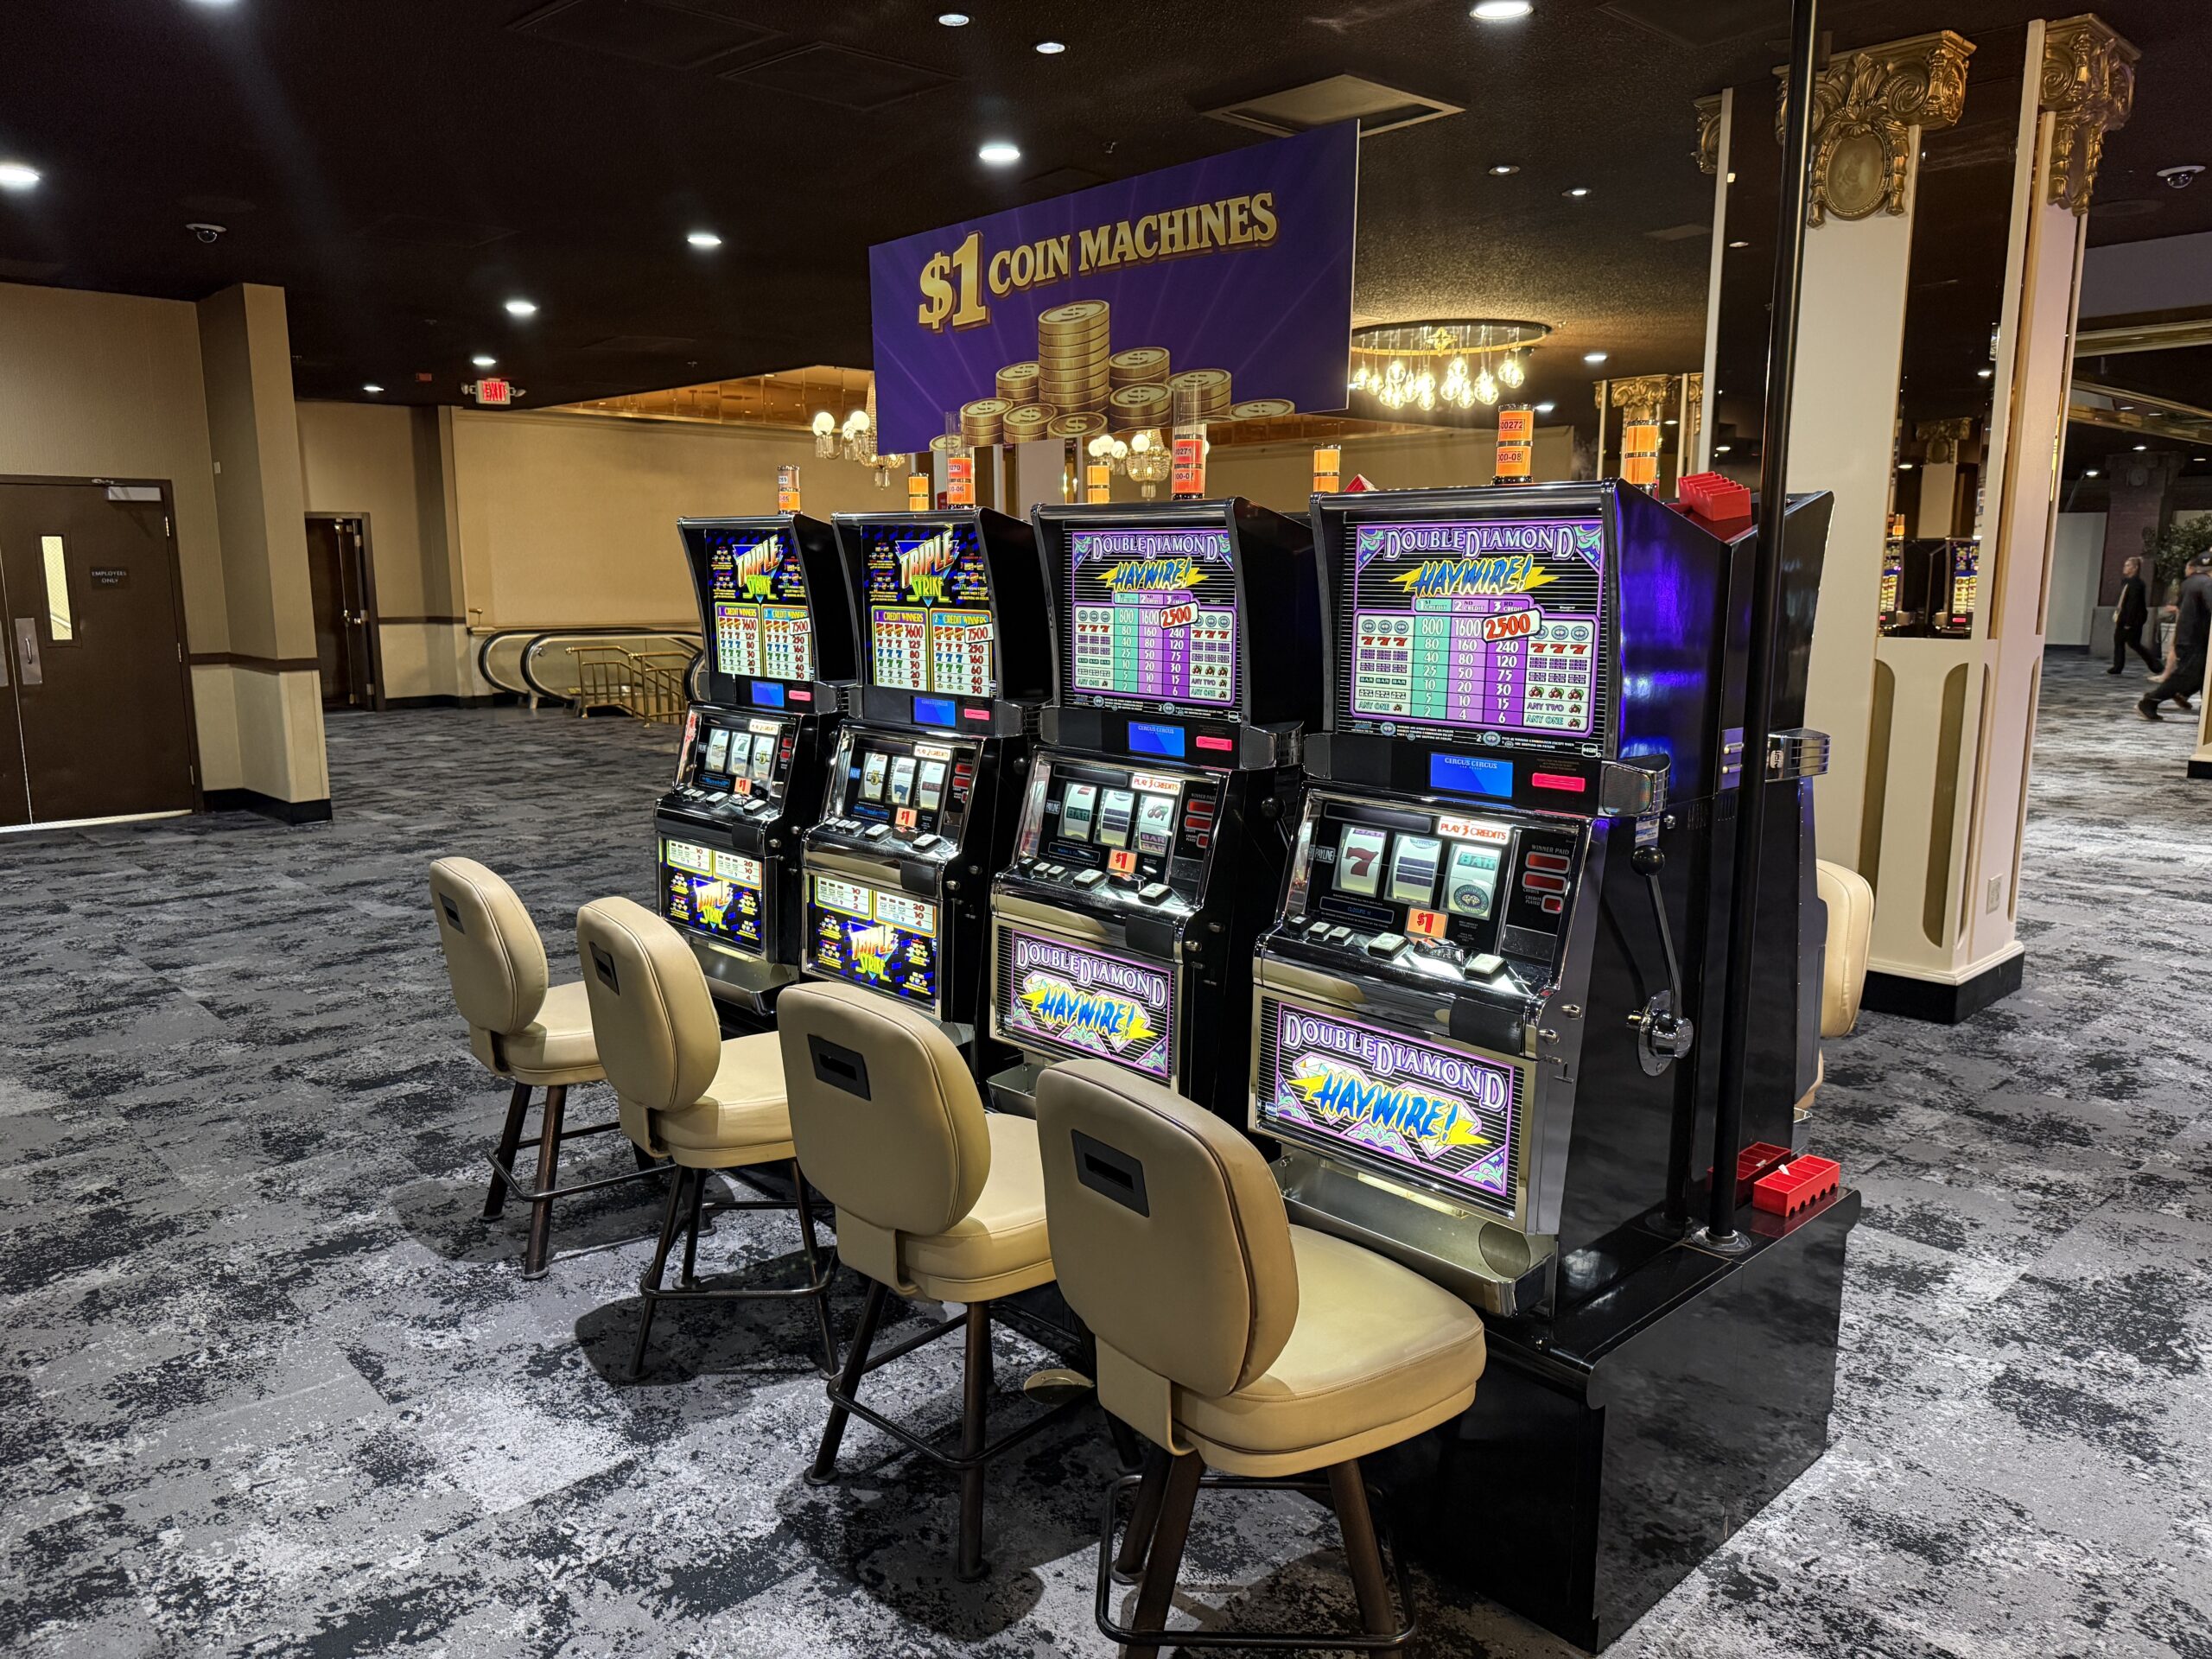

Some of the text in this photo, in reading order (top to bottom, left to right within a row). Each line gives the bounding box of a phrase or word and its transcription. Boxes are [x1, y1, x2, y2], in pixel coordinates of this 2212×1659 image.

[918, 192, 1278, 331] $1 COIN MACHINES
[483, 380, 506, 402] EXIT
[735, 534, 779, 588] TRIPLE
[899, 528, 955, 589] TRIPLE
[1109, 557, 1192, 592] HAYWIRE!
[1408, 554, 1534, 597] HAYWIRE!
[906, 575, 950, 603] STRIKE
[883, 612, 924, 622] CREDIT WINNERS
[944, 614, 987, 624] CREDIT WINNERS
[1119, 605, 1192, 627] 800 1600 2500
[791, 620, 809, 632] 7500
[967, 626, 988, 641] 7500
[1121, 626, 1185, 639] 80 160 240
[1421, 613, 1531, 640] 800 1600 2500
[1121, 638, 1185, 650] 40 80 120
[1424, 638, 1519, 653] 80 160 240
[969, 655, 984, 664] 160
[1121, 648, 1181, 662] 25 50 75
[1424, 652, 1440, 663] 40
[1458, 653, 1474, 664] 80
[1496, 655, 1517, 668] 120
[970, 665, 982, 675] 60
[1122, 659, 1181, 673] 10 20 30
[1423, 665, 1513, 682] 25 50 75
[970, 677, 982, 686] 40
[1123, 671, 1180, 684] 5 10 15
[1123, 683, 1179, 696] 2 4 6
[1424, 679, 1436, 690] 10
[1457, 681, 1472, 693] 20
[1496, 683, 1512, 696] 30
[1426, 692, 1510, 710] 5 10 15
[1526, 702, 1565, 712] ANY TWO
[1424, 706, 1506, 724] 2 4 6
[1525, 715, 1564, 725] ANY ONE
[1445, 757, 1471, 766] CIRCUS
[1147, 779, 1154, 789] 3
[1154, 781, 1179, 791] CREDITS
[900, 810, 910, 824] $1
[1067, 808, 1090, 820] BAR
[1141, 833, 1165, 843] BAR
[1440, 823, 1507, 840] PLAY 3 CREDITS
[1143, 842, 1165, 852] BAR
[1314, 848, 1334, 861] PAYLINE
[1531, 844, 1570, 855] WINNER PAID
[1115, 852, 1128, 869] $1
[1345, 846, 1379, 878] 7
[1458, 854, 1496, 870] BAR
[912, 903, 925, 912] 20
[1416, 912, 1434, 934] $1
[855, 953, 893, 982] STRIKE
[1037, 986, 1135, 1037] HAYWIRE!
[1311, 1069, 1462, 1146] HAYWIRE!
